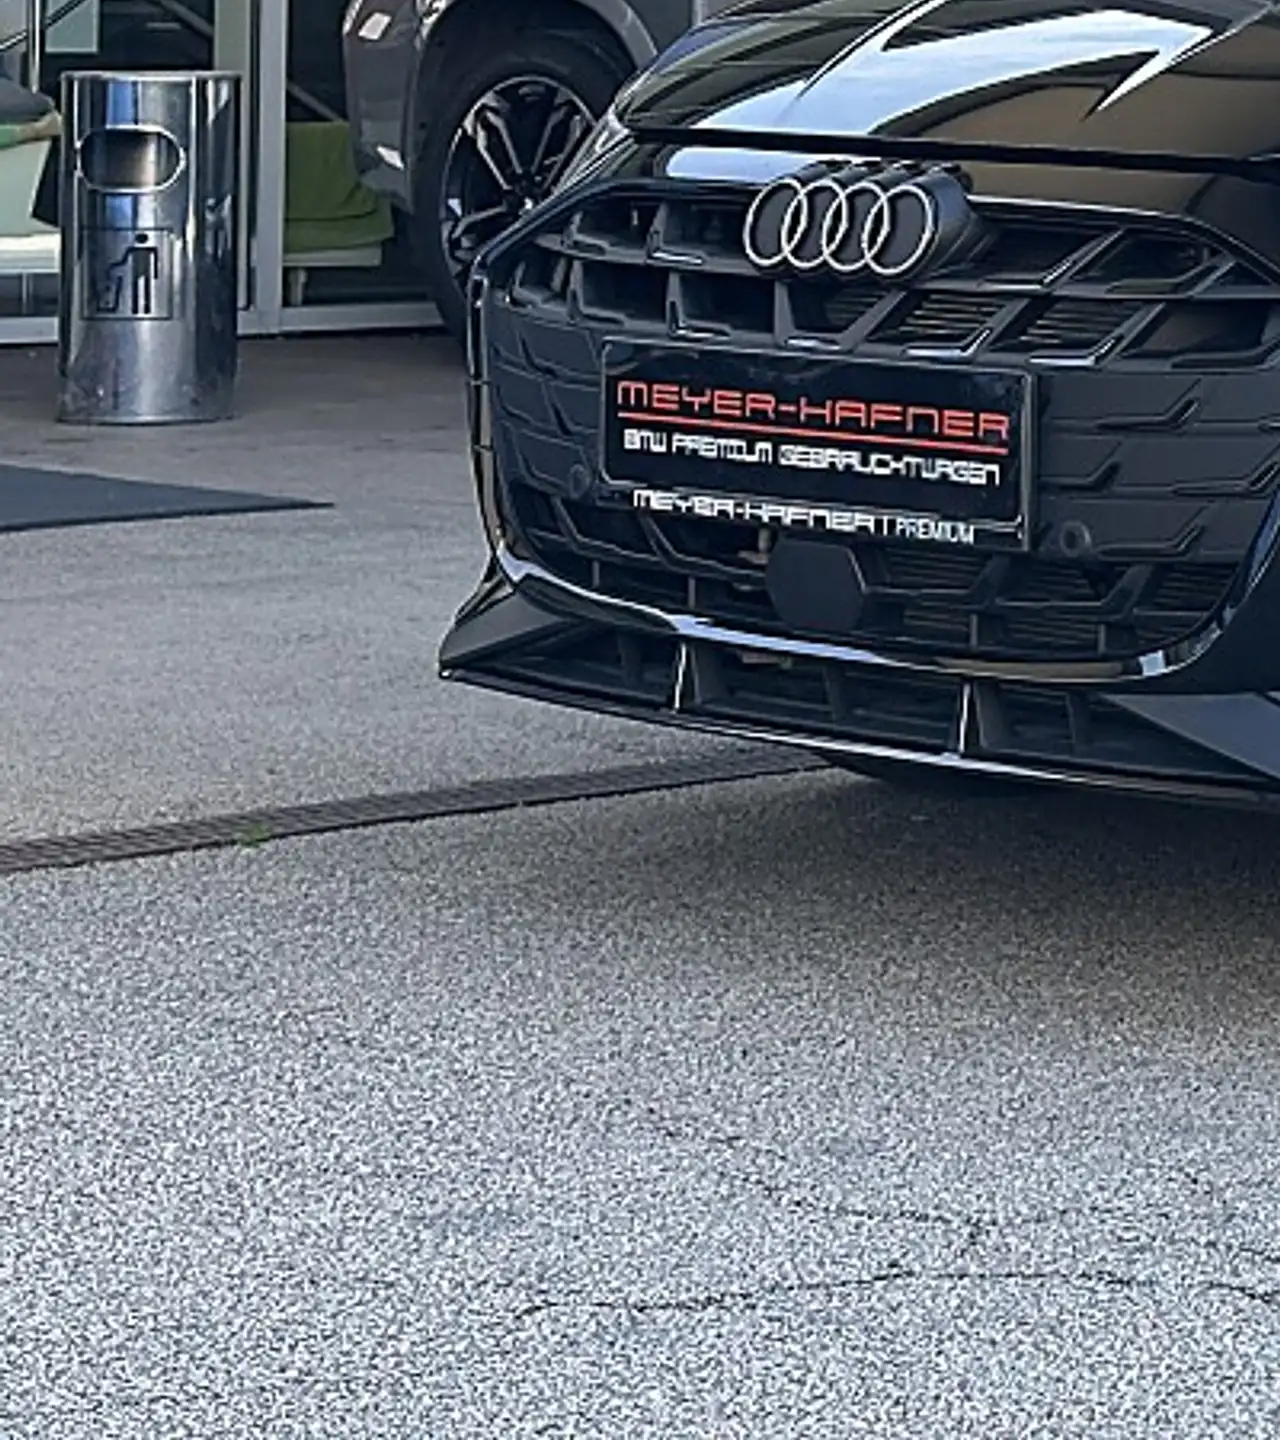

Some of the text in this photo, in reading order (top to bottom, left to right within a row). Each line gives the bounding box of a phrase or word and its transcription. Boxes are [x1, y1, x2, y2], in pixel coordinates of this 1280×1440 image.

[617, 380, 1009, 440] MEYER-HAFNER
[623, 428, 1000, 486] BMW PREMIUM GEBRAUCHTWAGEN
[632, 488, 975, 545] MEYER-HAFNER PREMIUM
